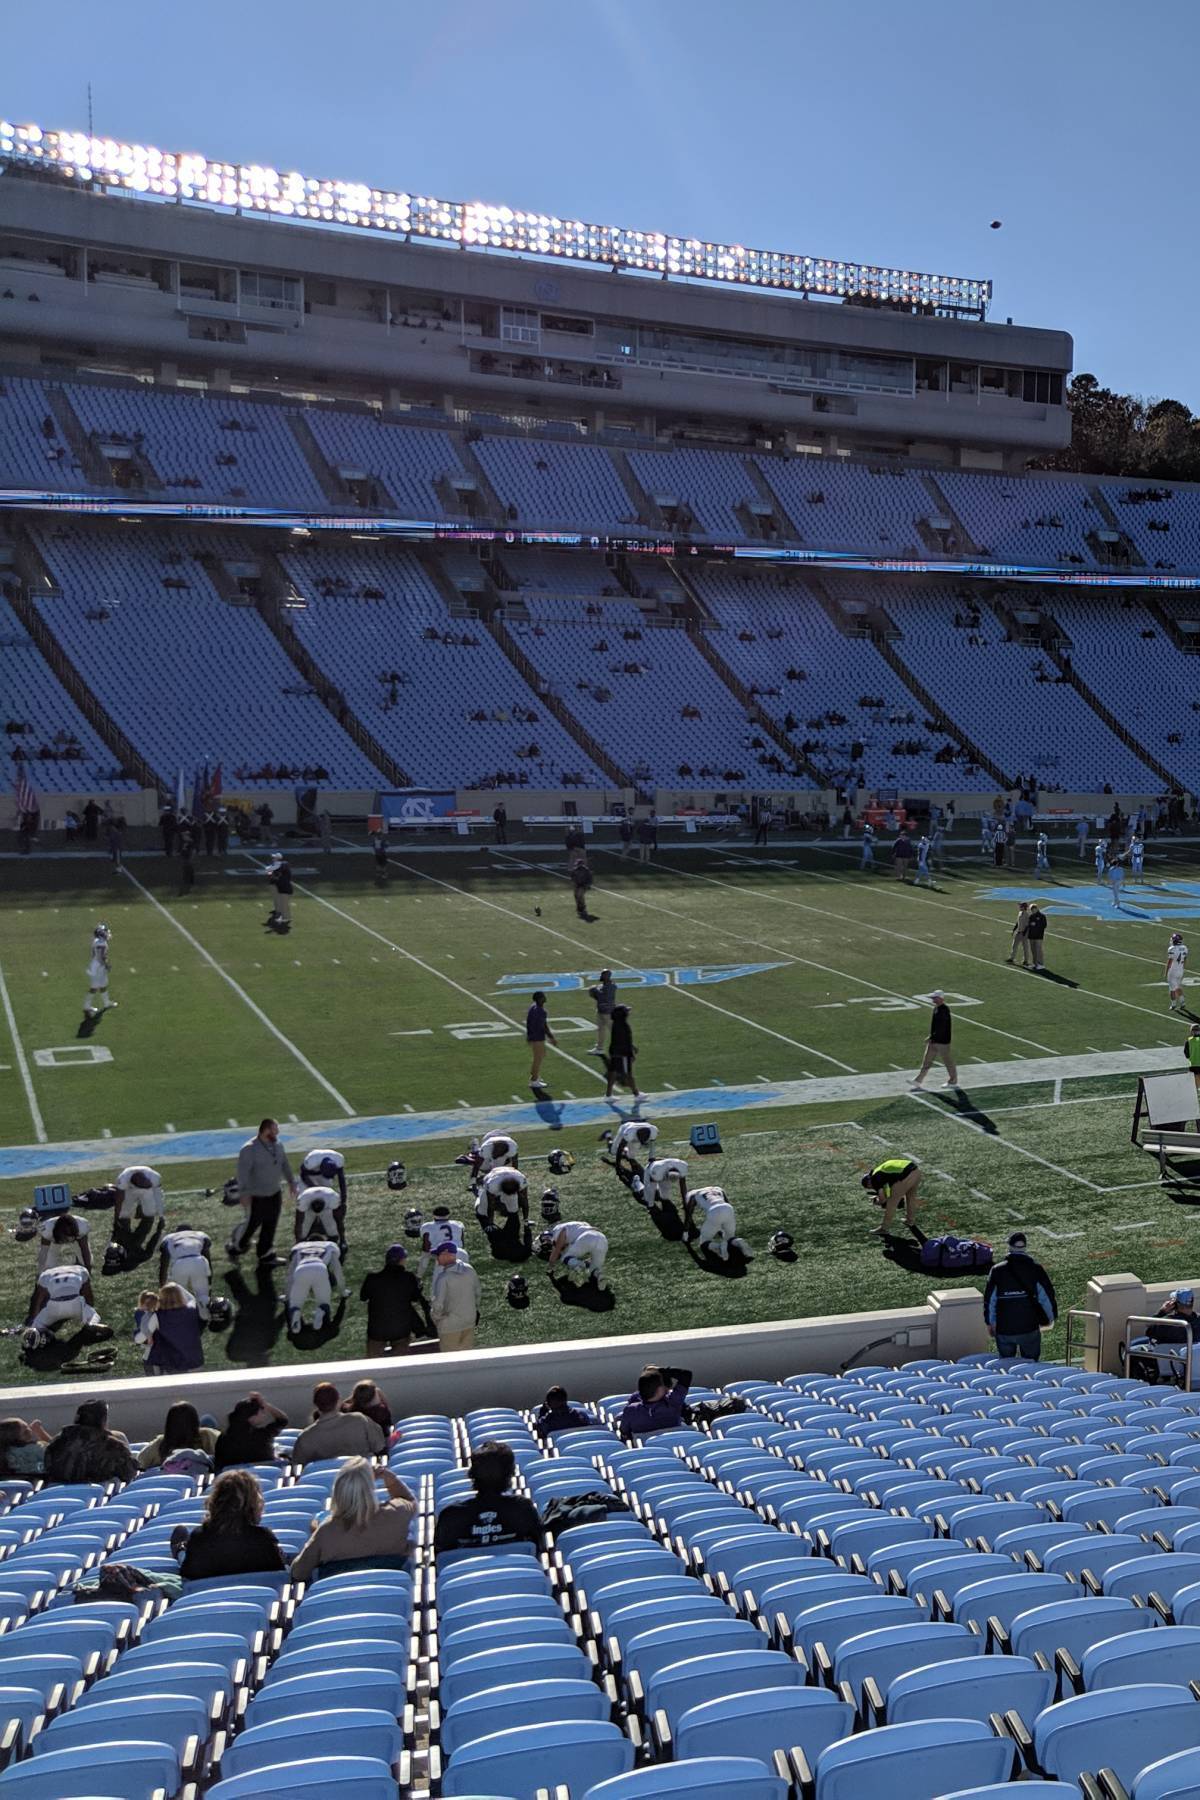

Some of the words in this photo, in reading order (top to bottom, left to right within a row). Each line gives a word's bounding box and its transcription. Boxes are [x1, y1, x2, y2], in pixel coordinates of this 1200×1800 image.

[442, 1016, 599, 1040] 20
[697, 1125, 716, 1141] 20
[40, 1186, 65, 1206] 10
[439, 1226, 453, 1242] 3
